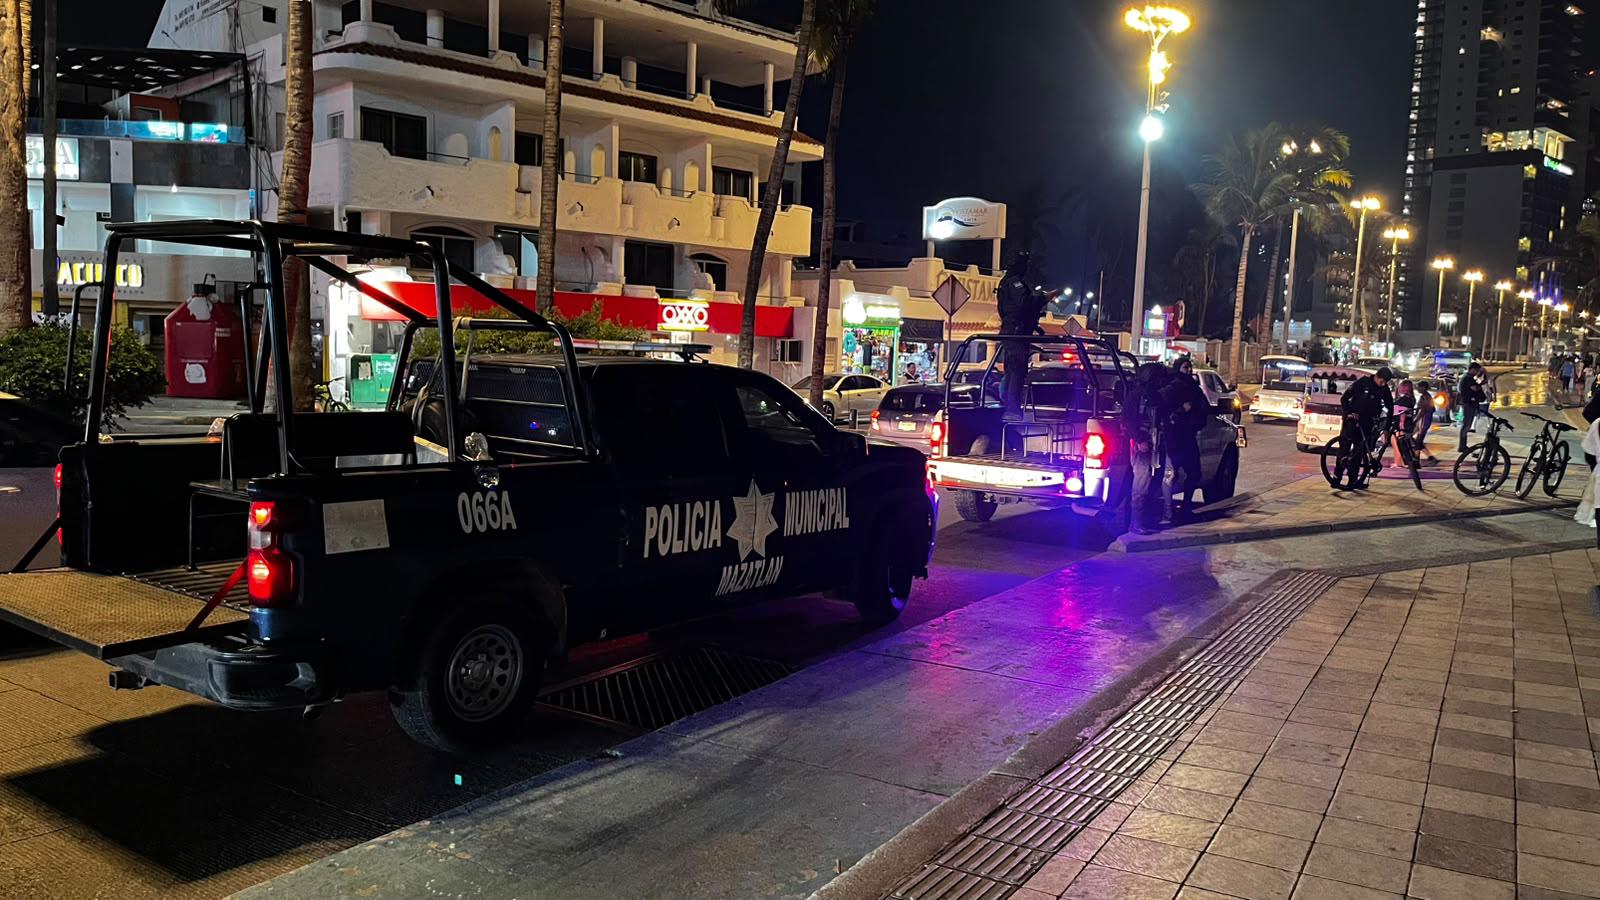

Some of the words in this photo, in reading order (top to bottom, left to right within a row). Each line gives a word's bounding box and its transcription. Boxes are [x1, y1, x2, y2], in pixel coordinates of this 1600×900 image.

[55, 262, 142, 287] ACICO
[662, 305, 708, 325] OXXO
[457, 490, 517, 534] 066A
[643, 500, 722, 559] POLICIA
[783, 488, 849, 537] MUNICIPAL
[715, 556, 784, 597] MAZATLAN
